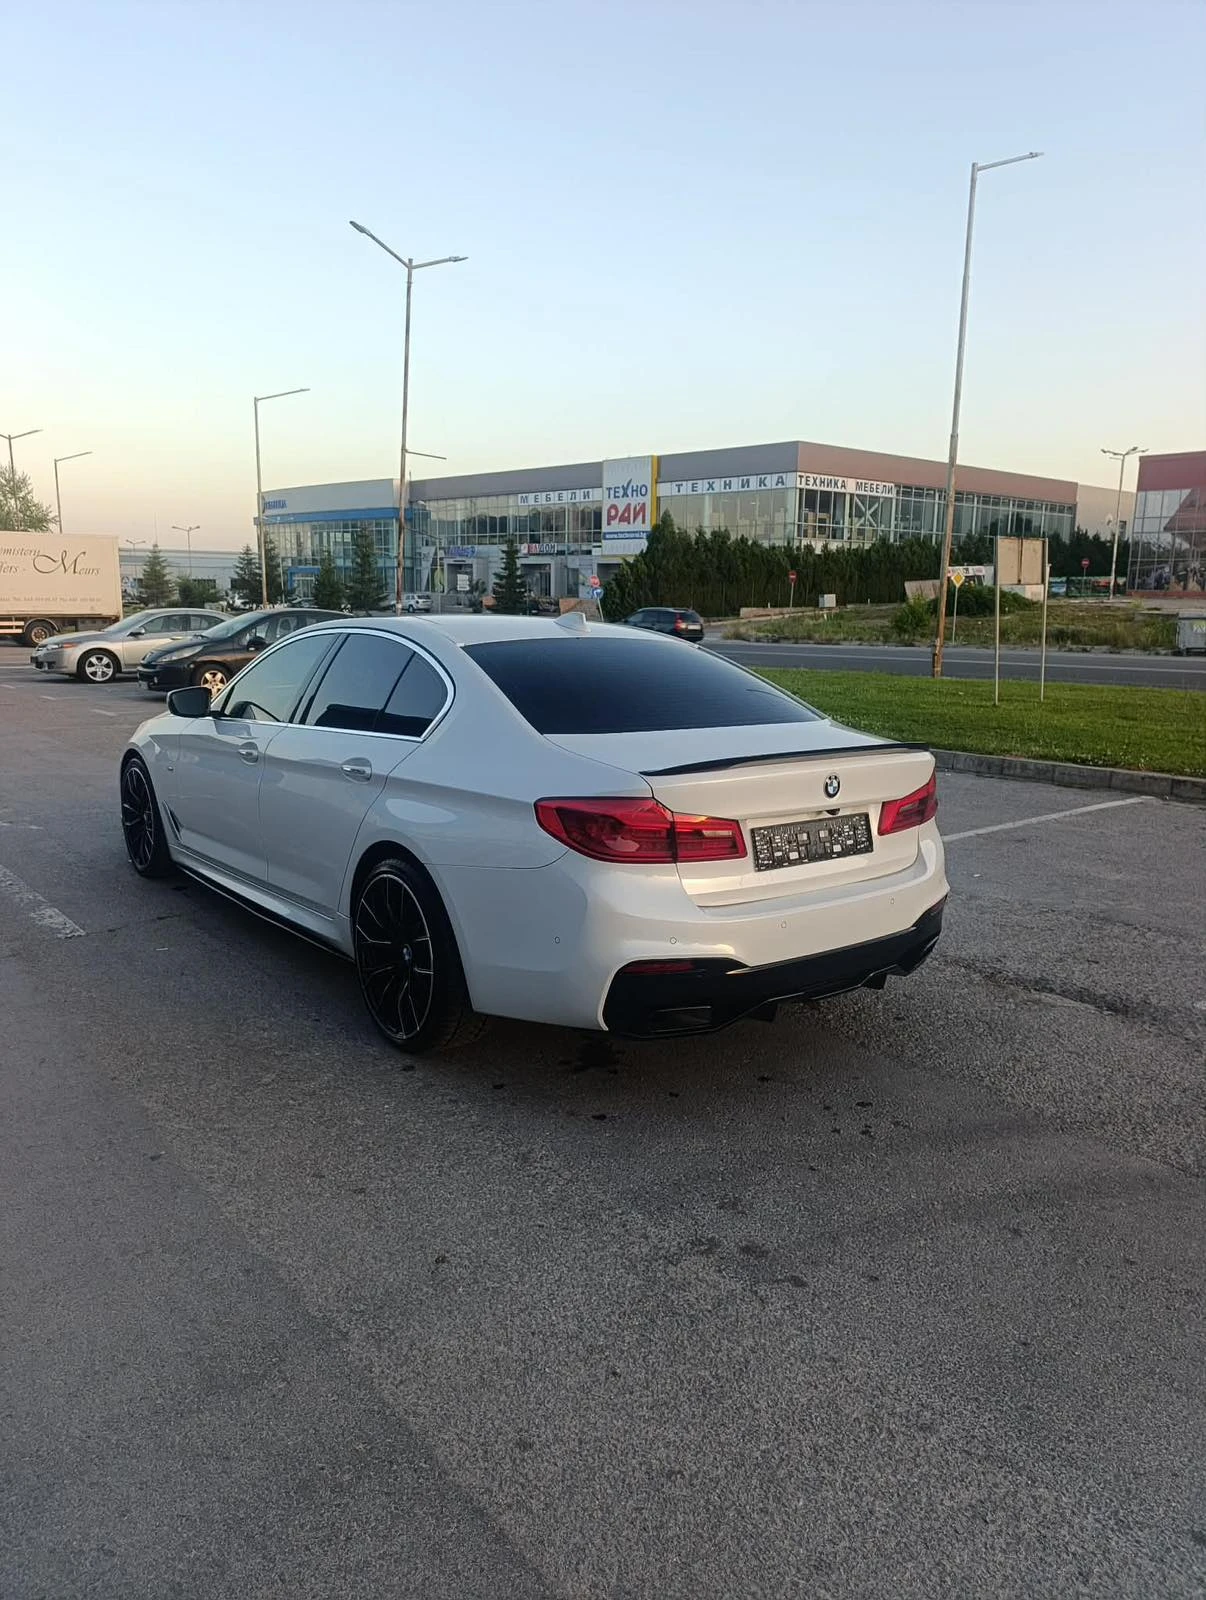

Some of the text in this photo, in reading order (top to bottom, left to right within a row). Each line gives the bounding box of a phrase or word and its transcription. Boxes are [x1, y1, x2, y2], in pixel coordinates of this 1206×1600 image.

[606, 478, 648, 499] ТЕХНО
[675, 475, 785, 493] ТЕХНИКА
[798, 475, 893, 495] ТЕХНИКА МЕБЕЛИ
[520, 490, 591, 504] МЕБЕЛИ
[607, 502, 646, 526] РАЙ
[33, 550, 100, 575] Meurs
